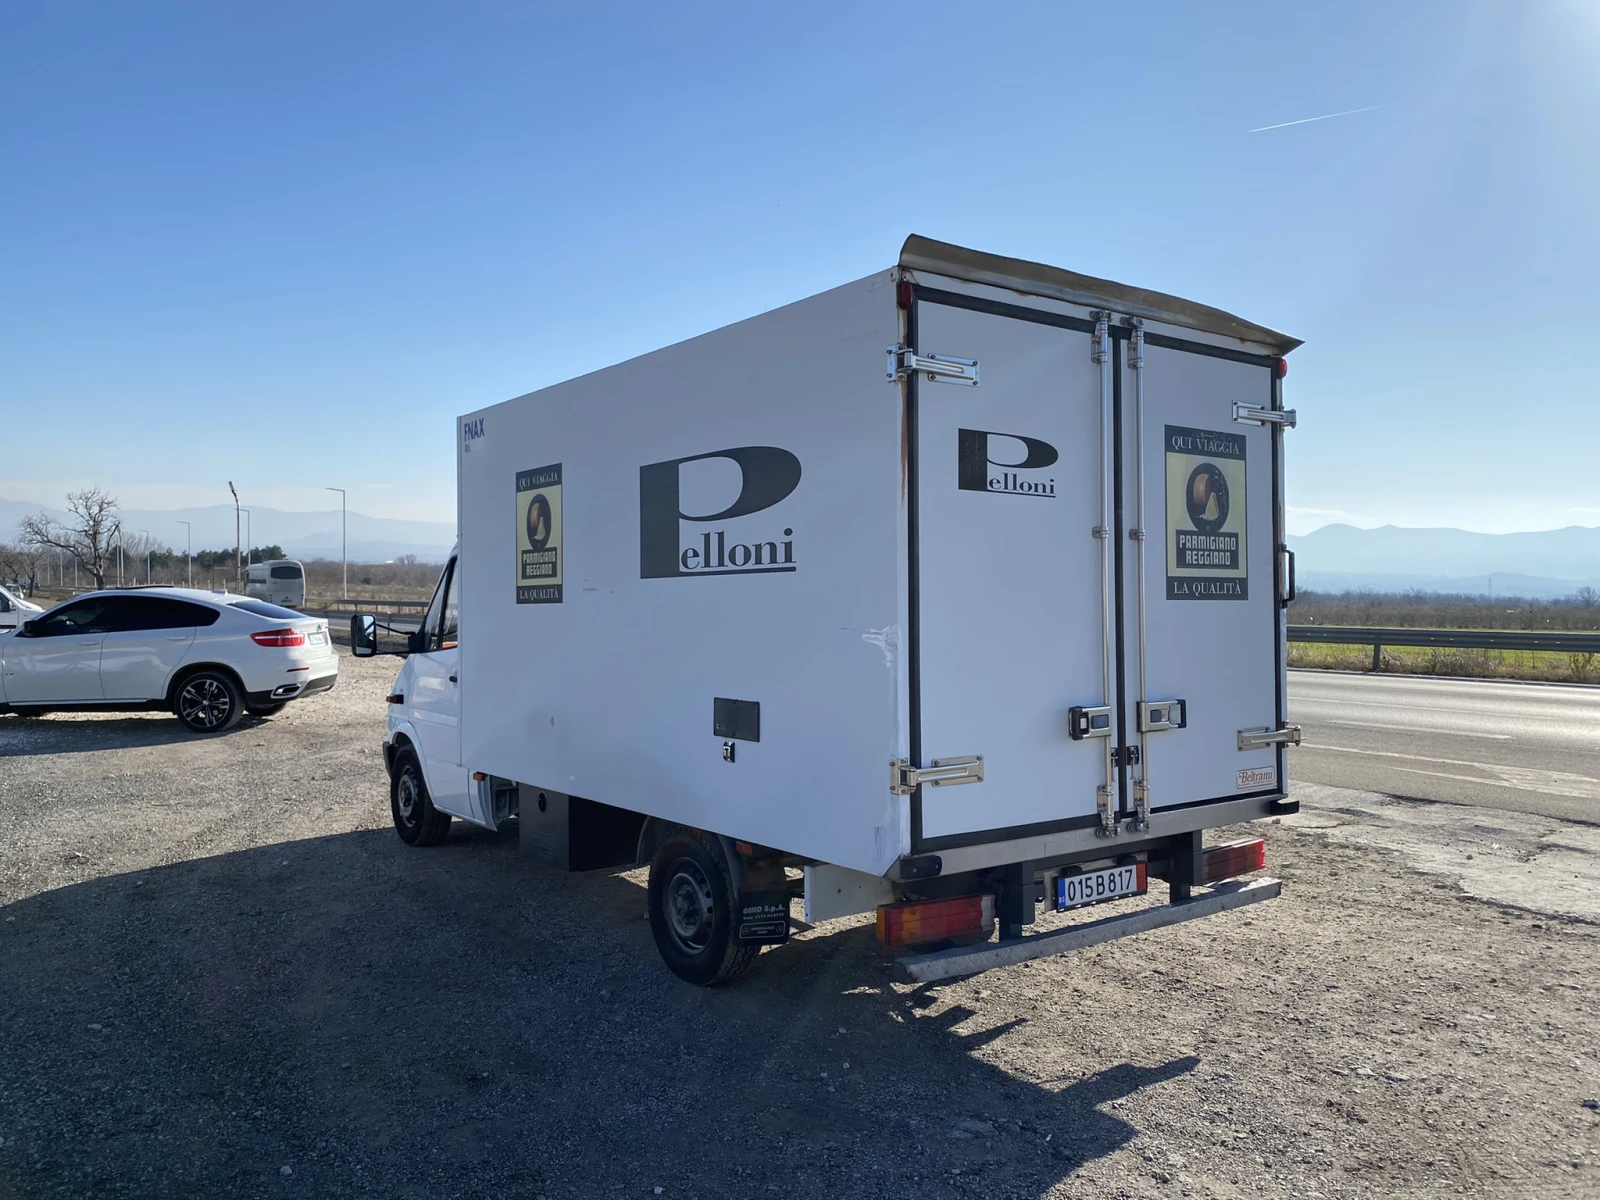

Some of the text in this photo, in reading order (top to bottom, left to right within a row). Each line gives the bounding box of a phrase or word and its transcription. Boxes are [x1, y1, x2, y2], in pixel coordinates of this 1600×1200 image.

[464, 417, 485, 442] FNAX
[1172, 435, 1240, 455] QUI VIAGGIA
[958, 427, 1059, 496] Pelloni
[519, 471, 558, 489] QUI VIAGGIA
[639, 446, 802, 579] Pelloni
[1179, 534, 1236, 551] PARMIGIANO
[522, 550, 556, 564] PARMIGIANO
[1185, 550, 1231, 566] REGGIANO
[526, 563, 553, 576] REGGIANO
[520, 586, 559, 601] LA QUALITÀ
[1173, 579, 1242, 597] LA QUALITÀ
[743, 904, 785, 914] GINO S.p.A.
